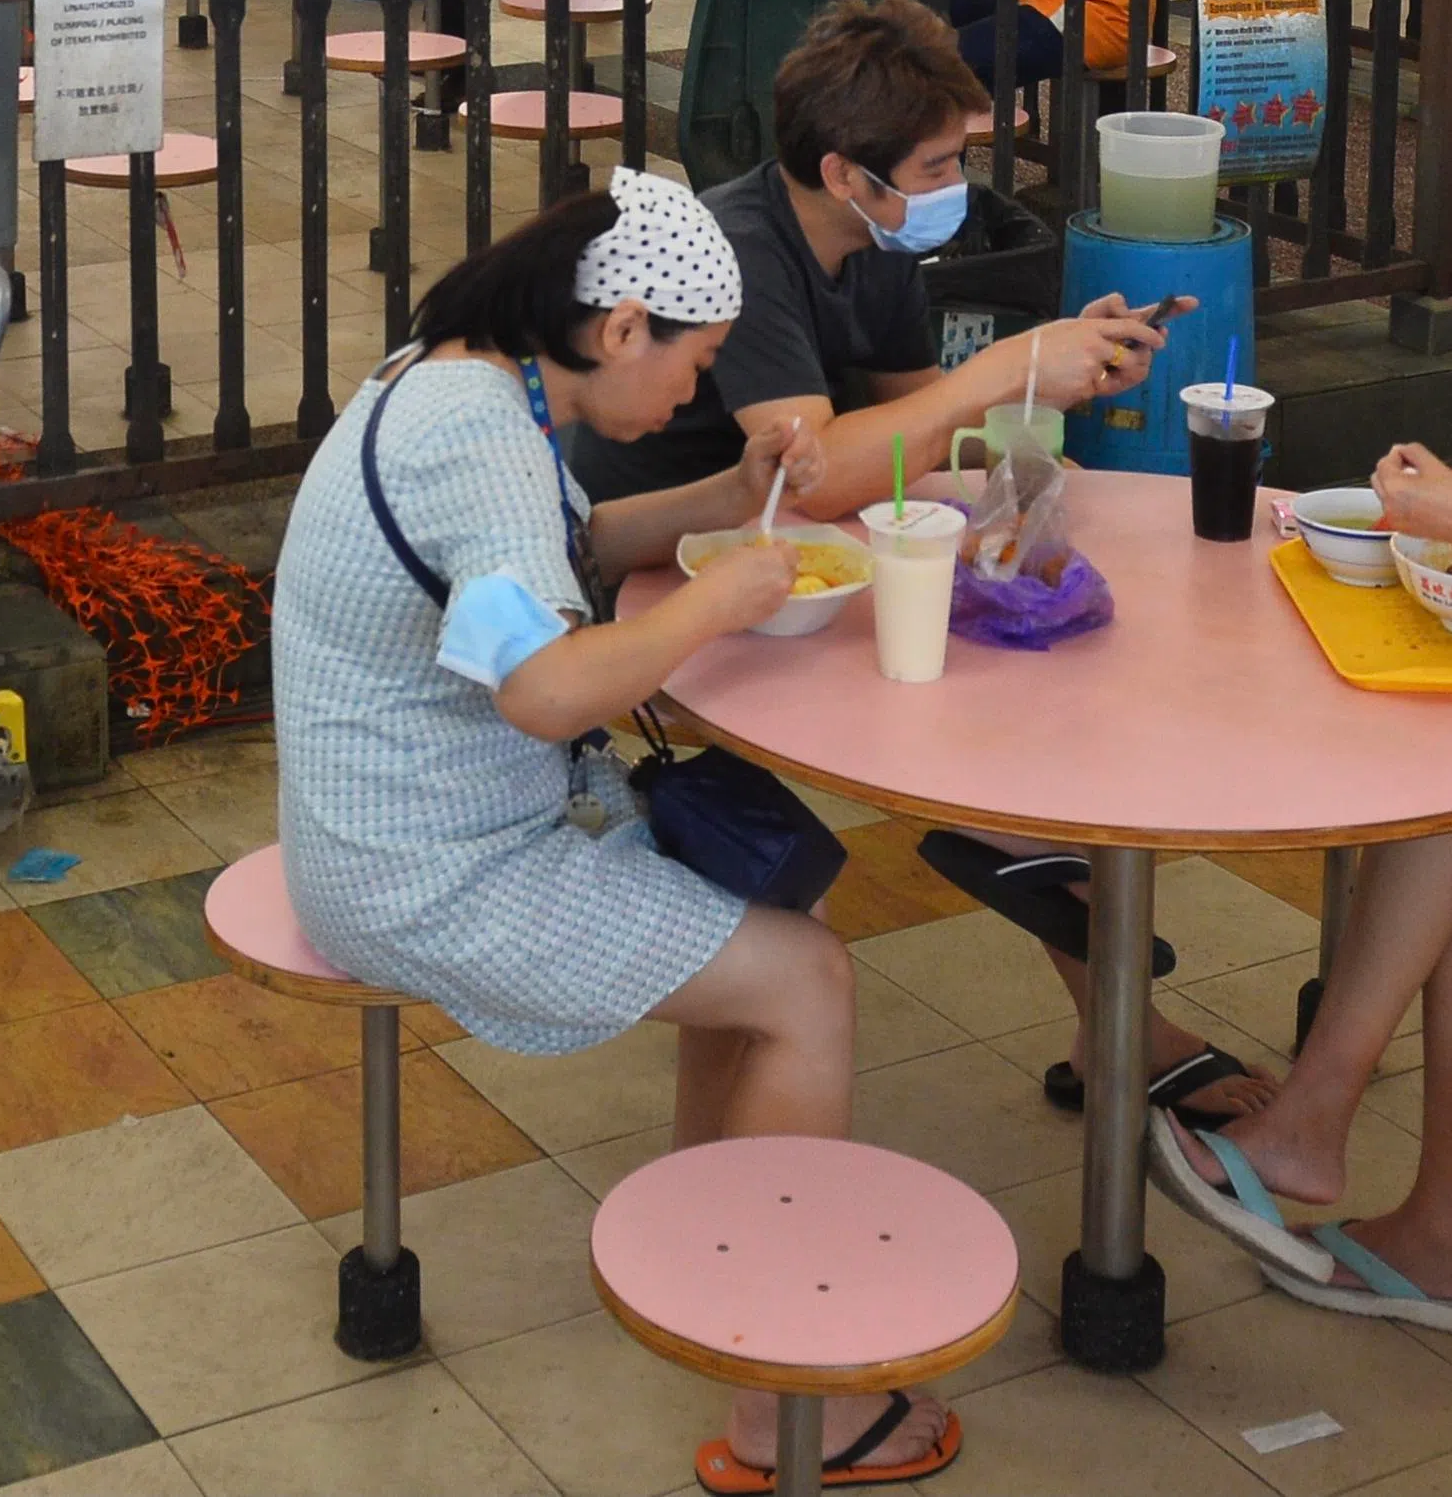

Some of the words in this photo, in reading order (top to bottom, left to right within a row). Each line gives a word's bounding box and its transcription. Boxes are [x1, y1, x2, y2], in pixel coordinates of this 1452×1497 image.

[63, 0, 136, 14] UNAUTHORIZED
[53, 19, 98, 32] DUMPING
[106, 15, 145, 26] PLACING
[50, 36, 62, 47] OF
[64, 34, 92, 46] ITEMS
[94, 30, 147, 44] PROHIBITED
